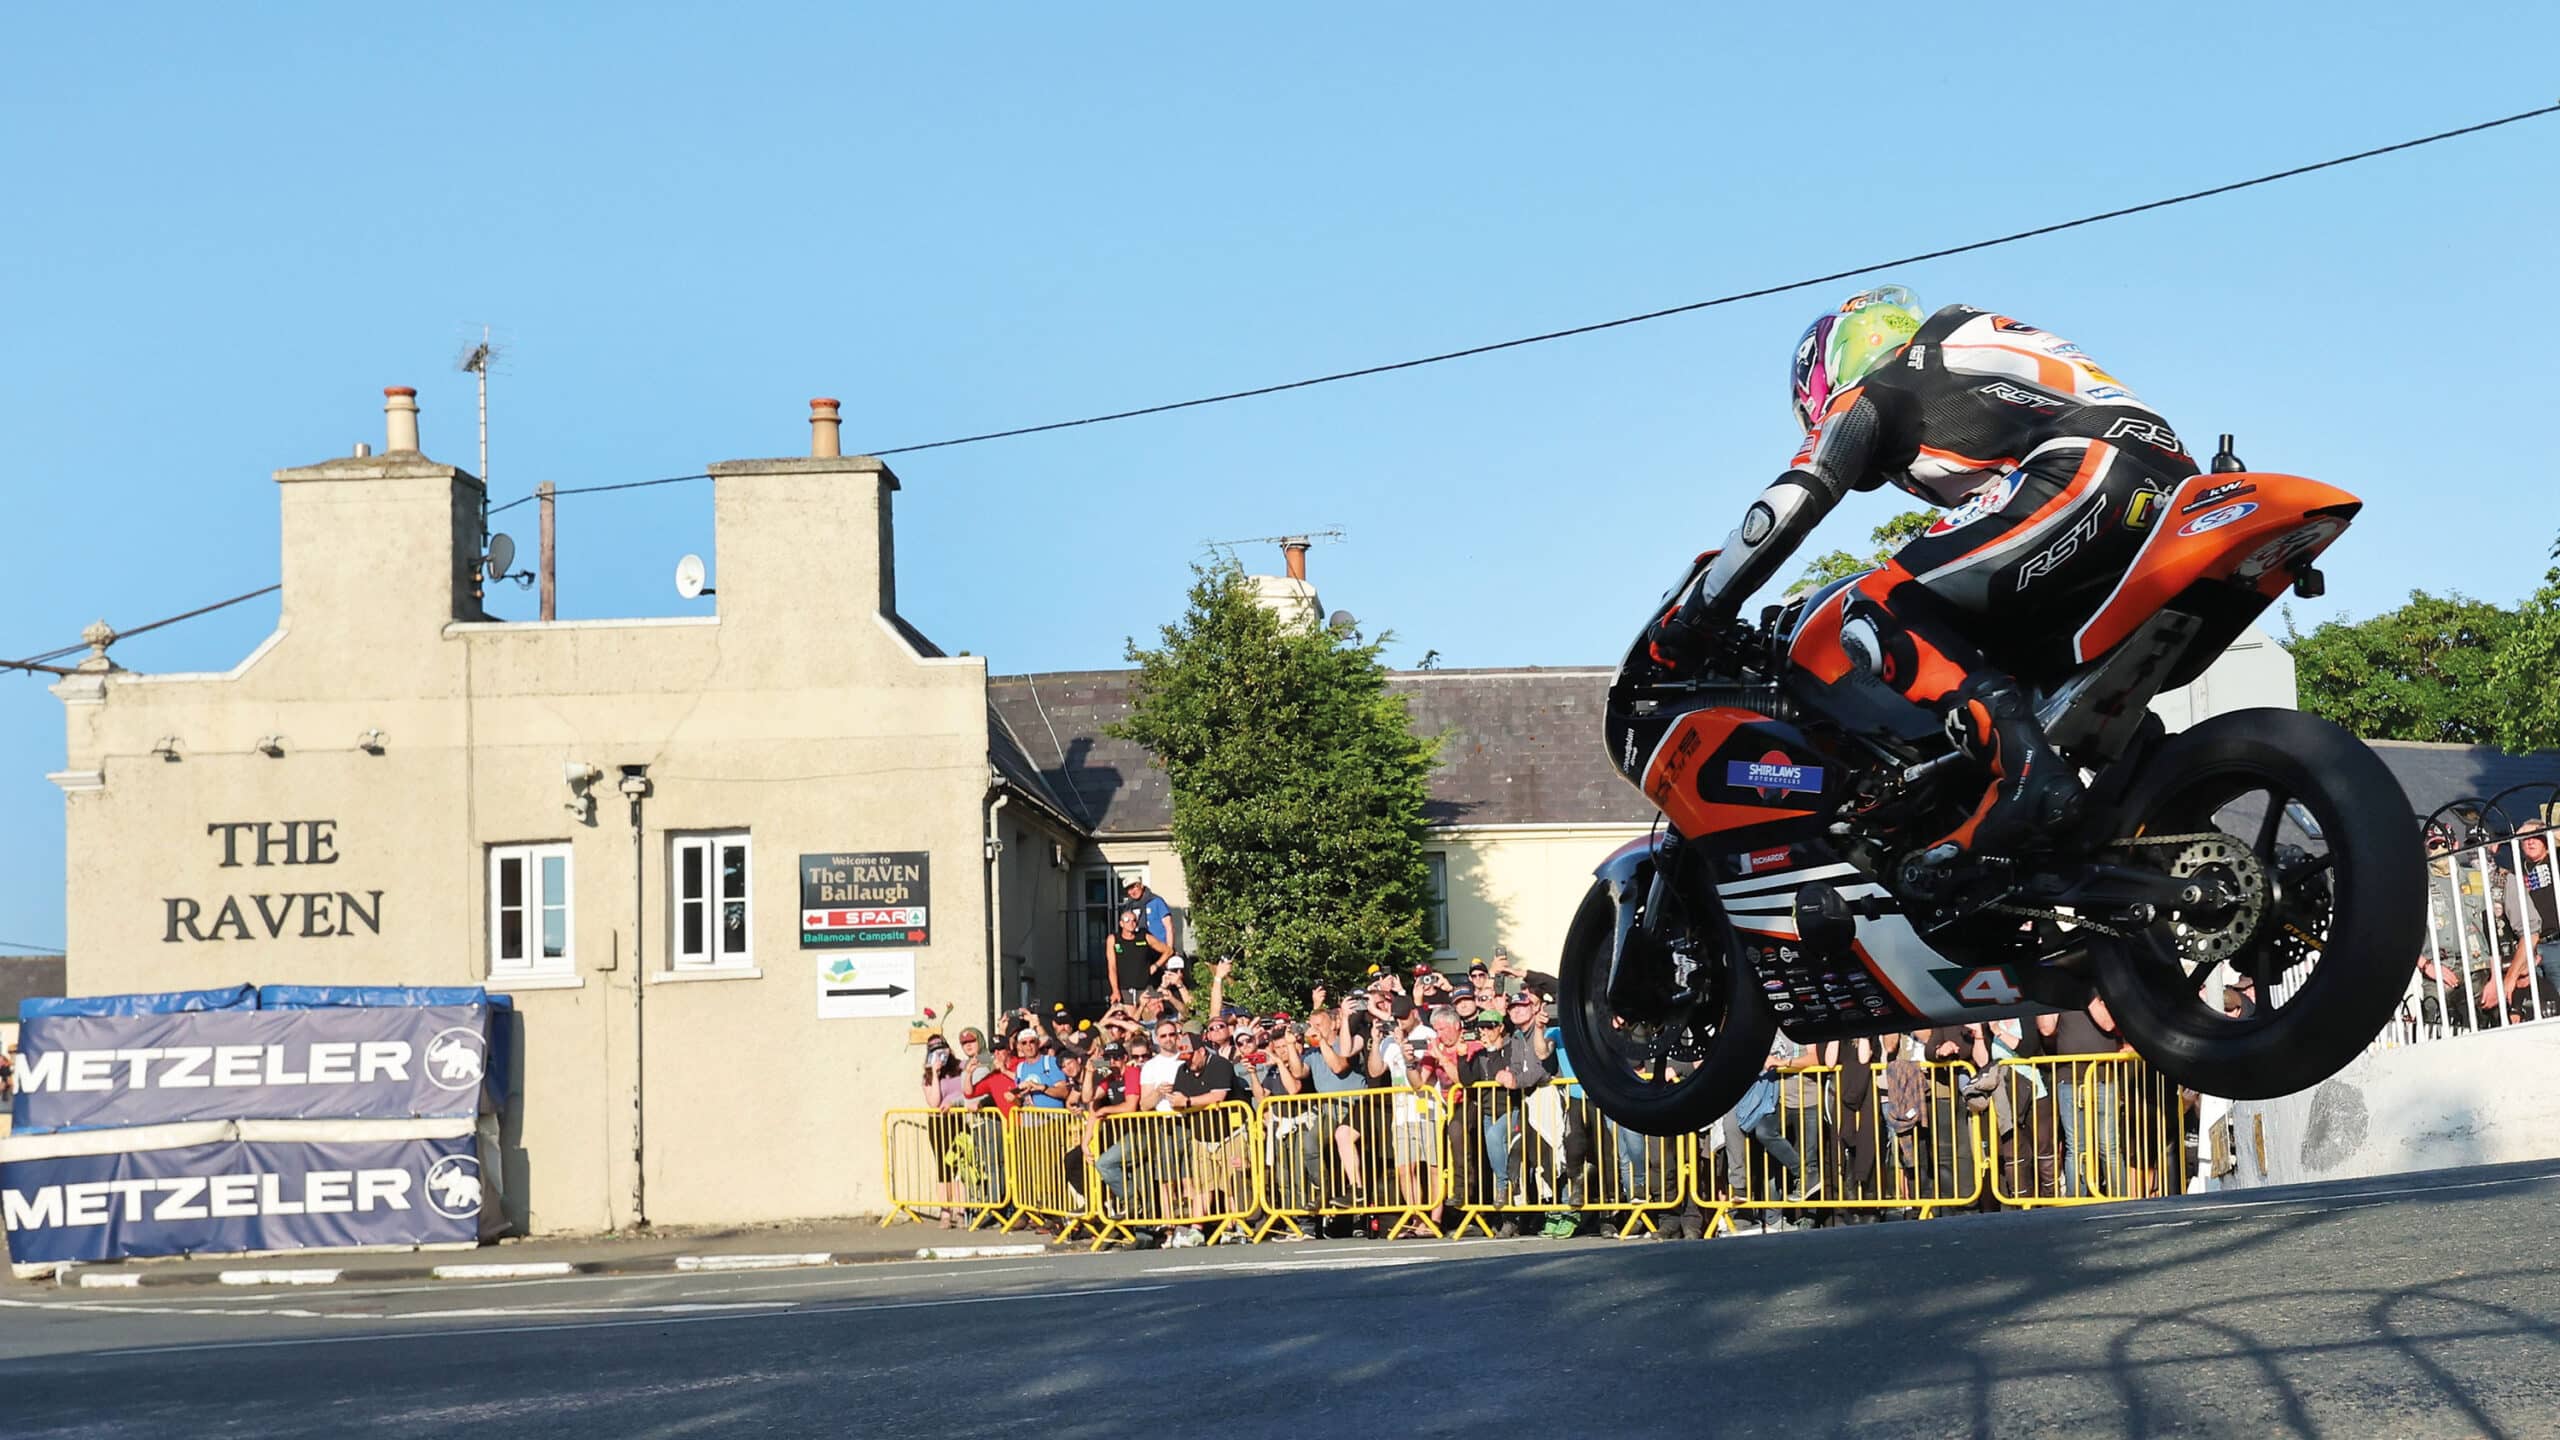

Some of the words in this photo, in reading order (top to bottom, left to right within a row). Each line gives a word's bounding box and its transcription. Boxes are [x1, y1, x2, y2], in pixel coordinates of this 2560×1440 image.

[1907, 344, 1926, 370] RST
[1979, 382, 2065, 409] RST
[2102, 416, 2191, 458] RS
[2016, 494, 2107, 592] RST
[1749, 763, 1801, 779] SHIRLAWS
[207, 819, 340, 868] THE
[831, 856, 877, 866] Welcome
[880, 856, 891, 865] to
[1752, 853, 1785, 866] RICHARDS
[809, 867, 846, 884] The
[853, 865, 920, 883] RAVEN
[820, 883, 910, 904] Ballaugh
[162, 890, 385, 943] RAVEN
[845, 910, 907, 925] SPAR
[803, 933, 855, 944] Ballamoar
[858, 931, 905, 942] Campsite
[1958, 968, 2022, 1004] 4
[12, 1040, 413, 1097] METZELER
[2, 1167, 413, 1232] METZELER
